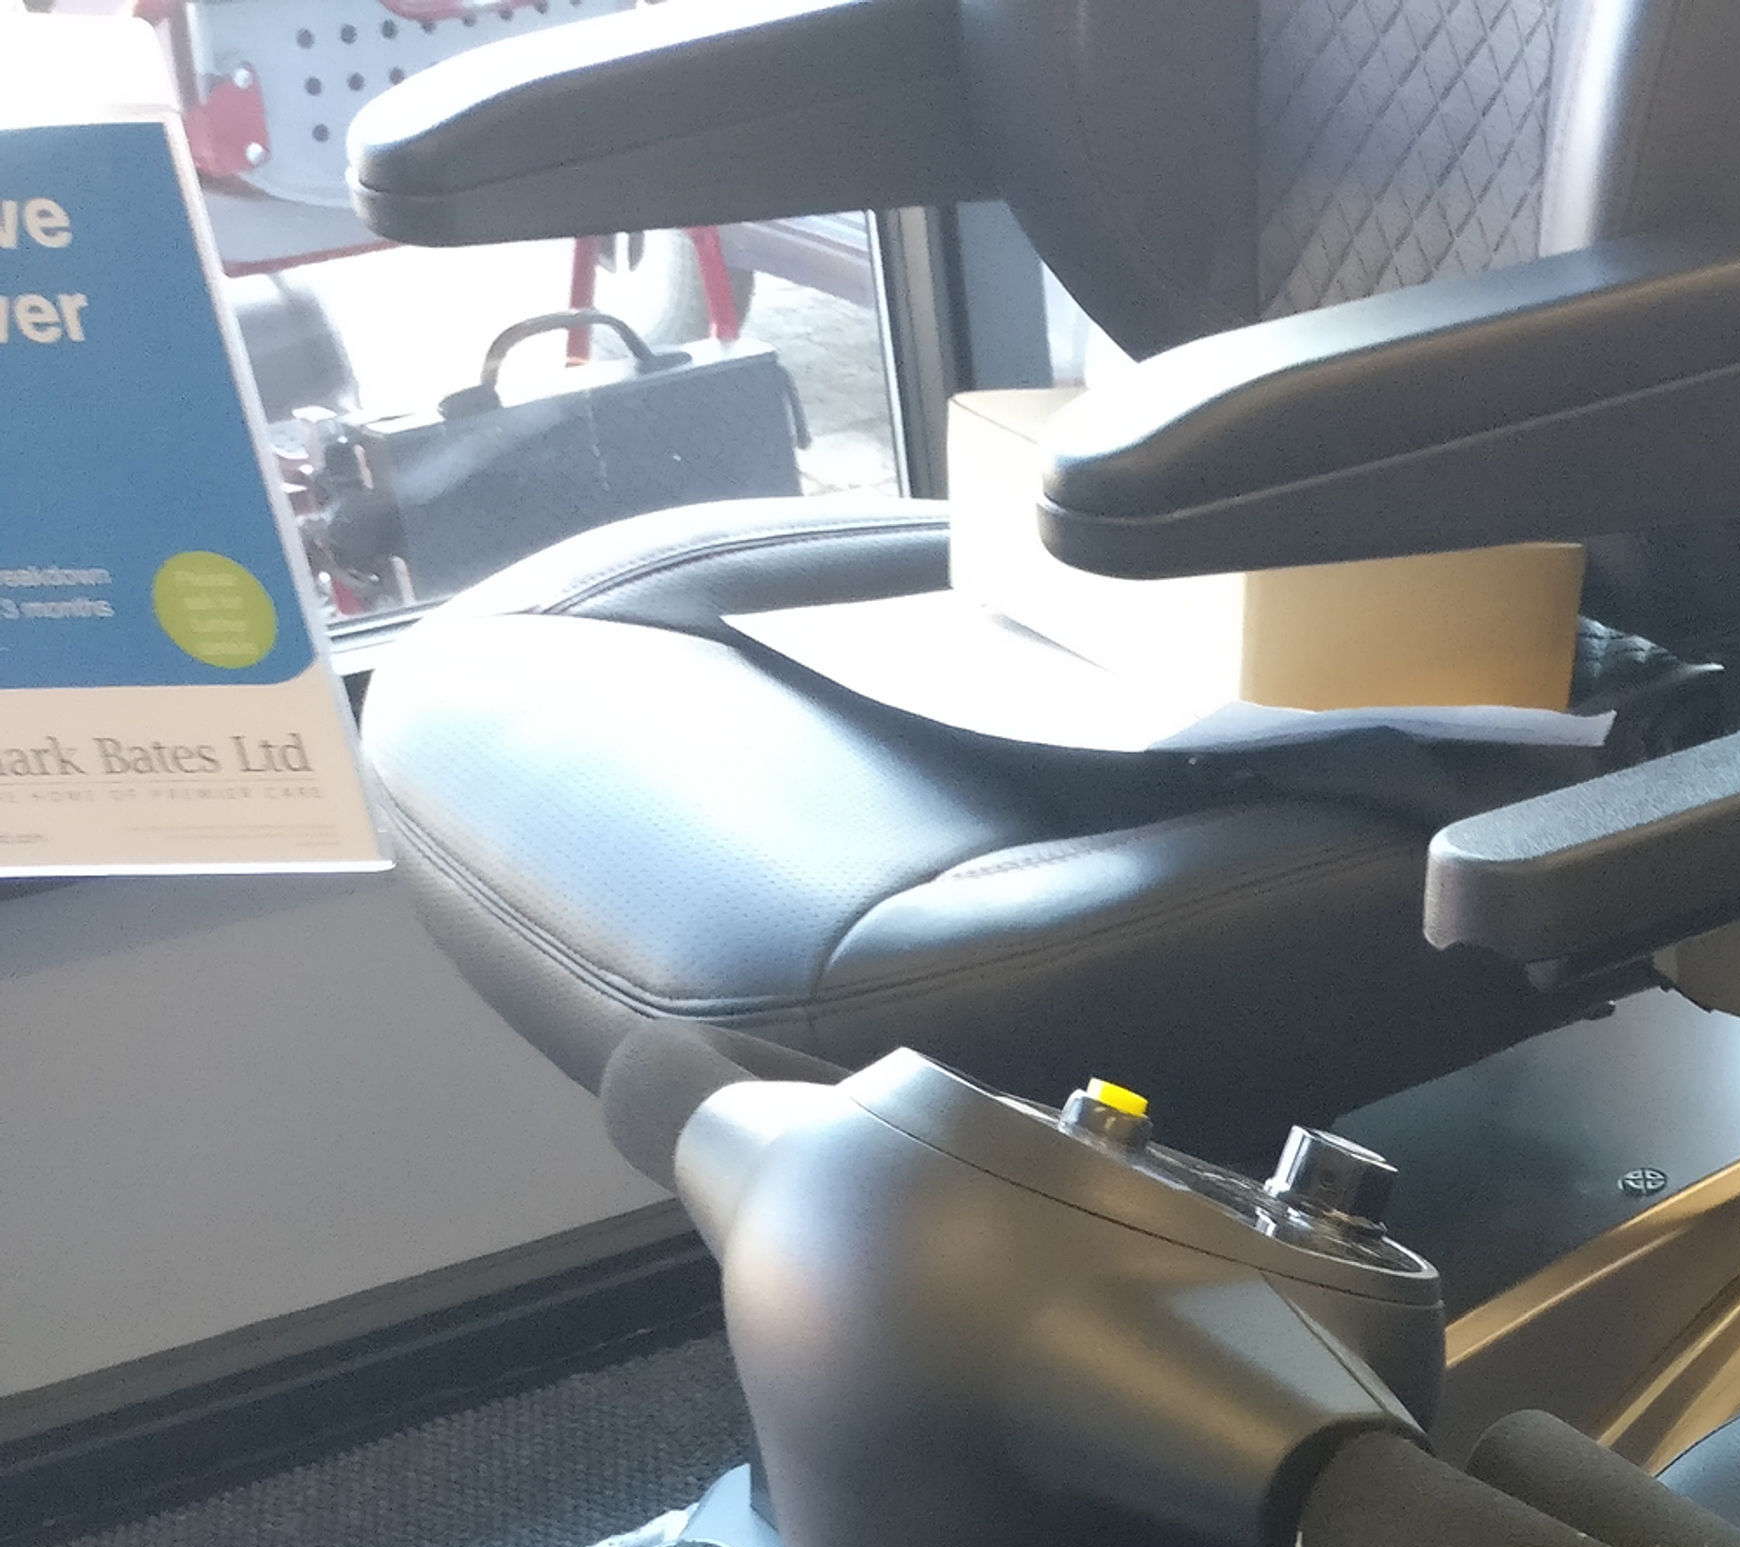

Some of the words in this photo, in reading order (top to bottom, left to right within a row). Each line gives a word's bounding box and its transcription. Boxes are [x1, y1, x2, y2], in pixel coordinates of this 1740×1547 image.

[0, 293, 88, 343] er
[0, 736, 88, 776] ark
[92, 737, 223, 776] Bates
[229, 732, 315, 773] Ltd
